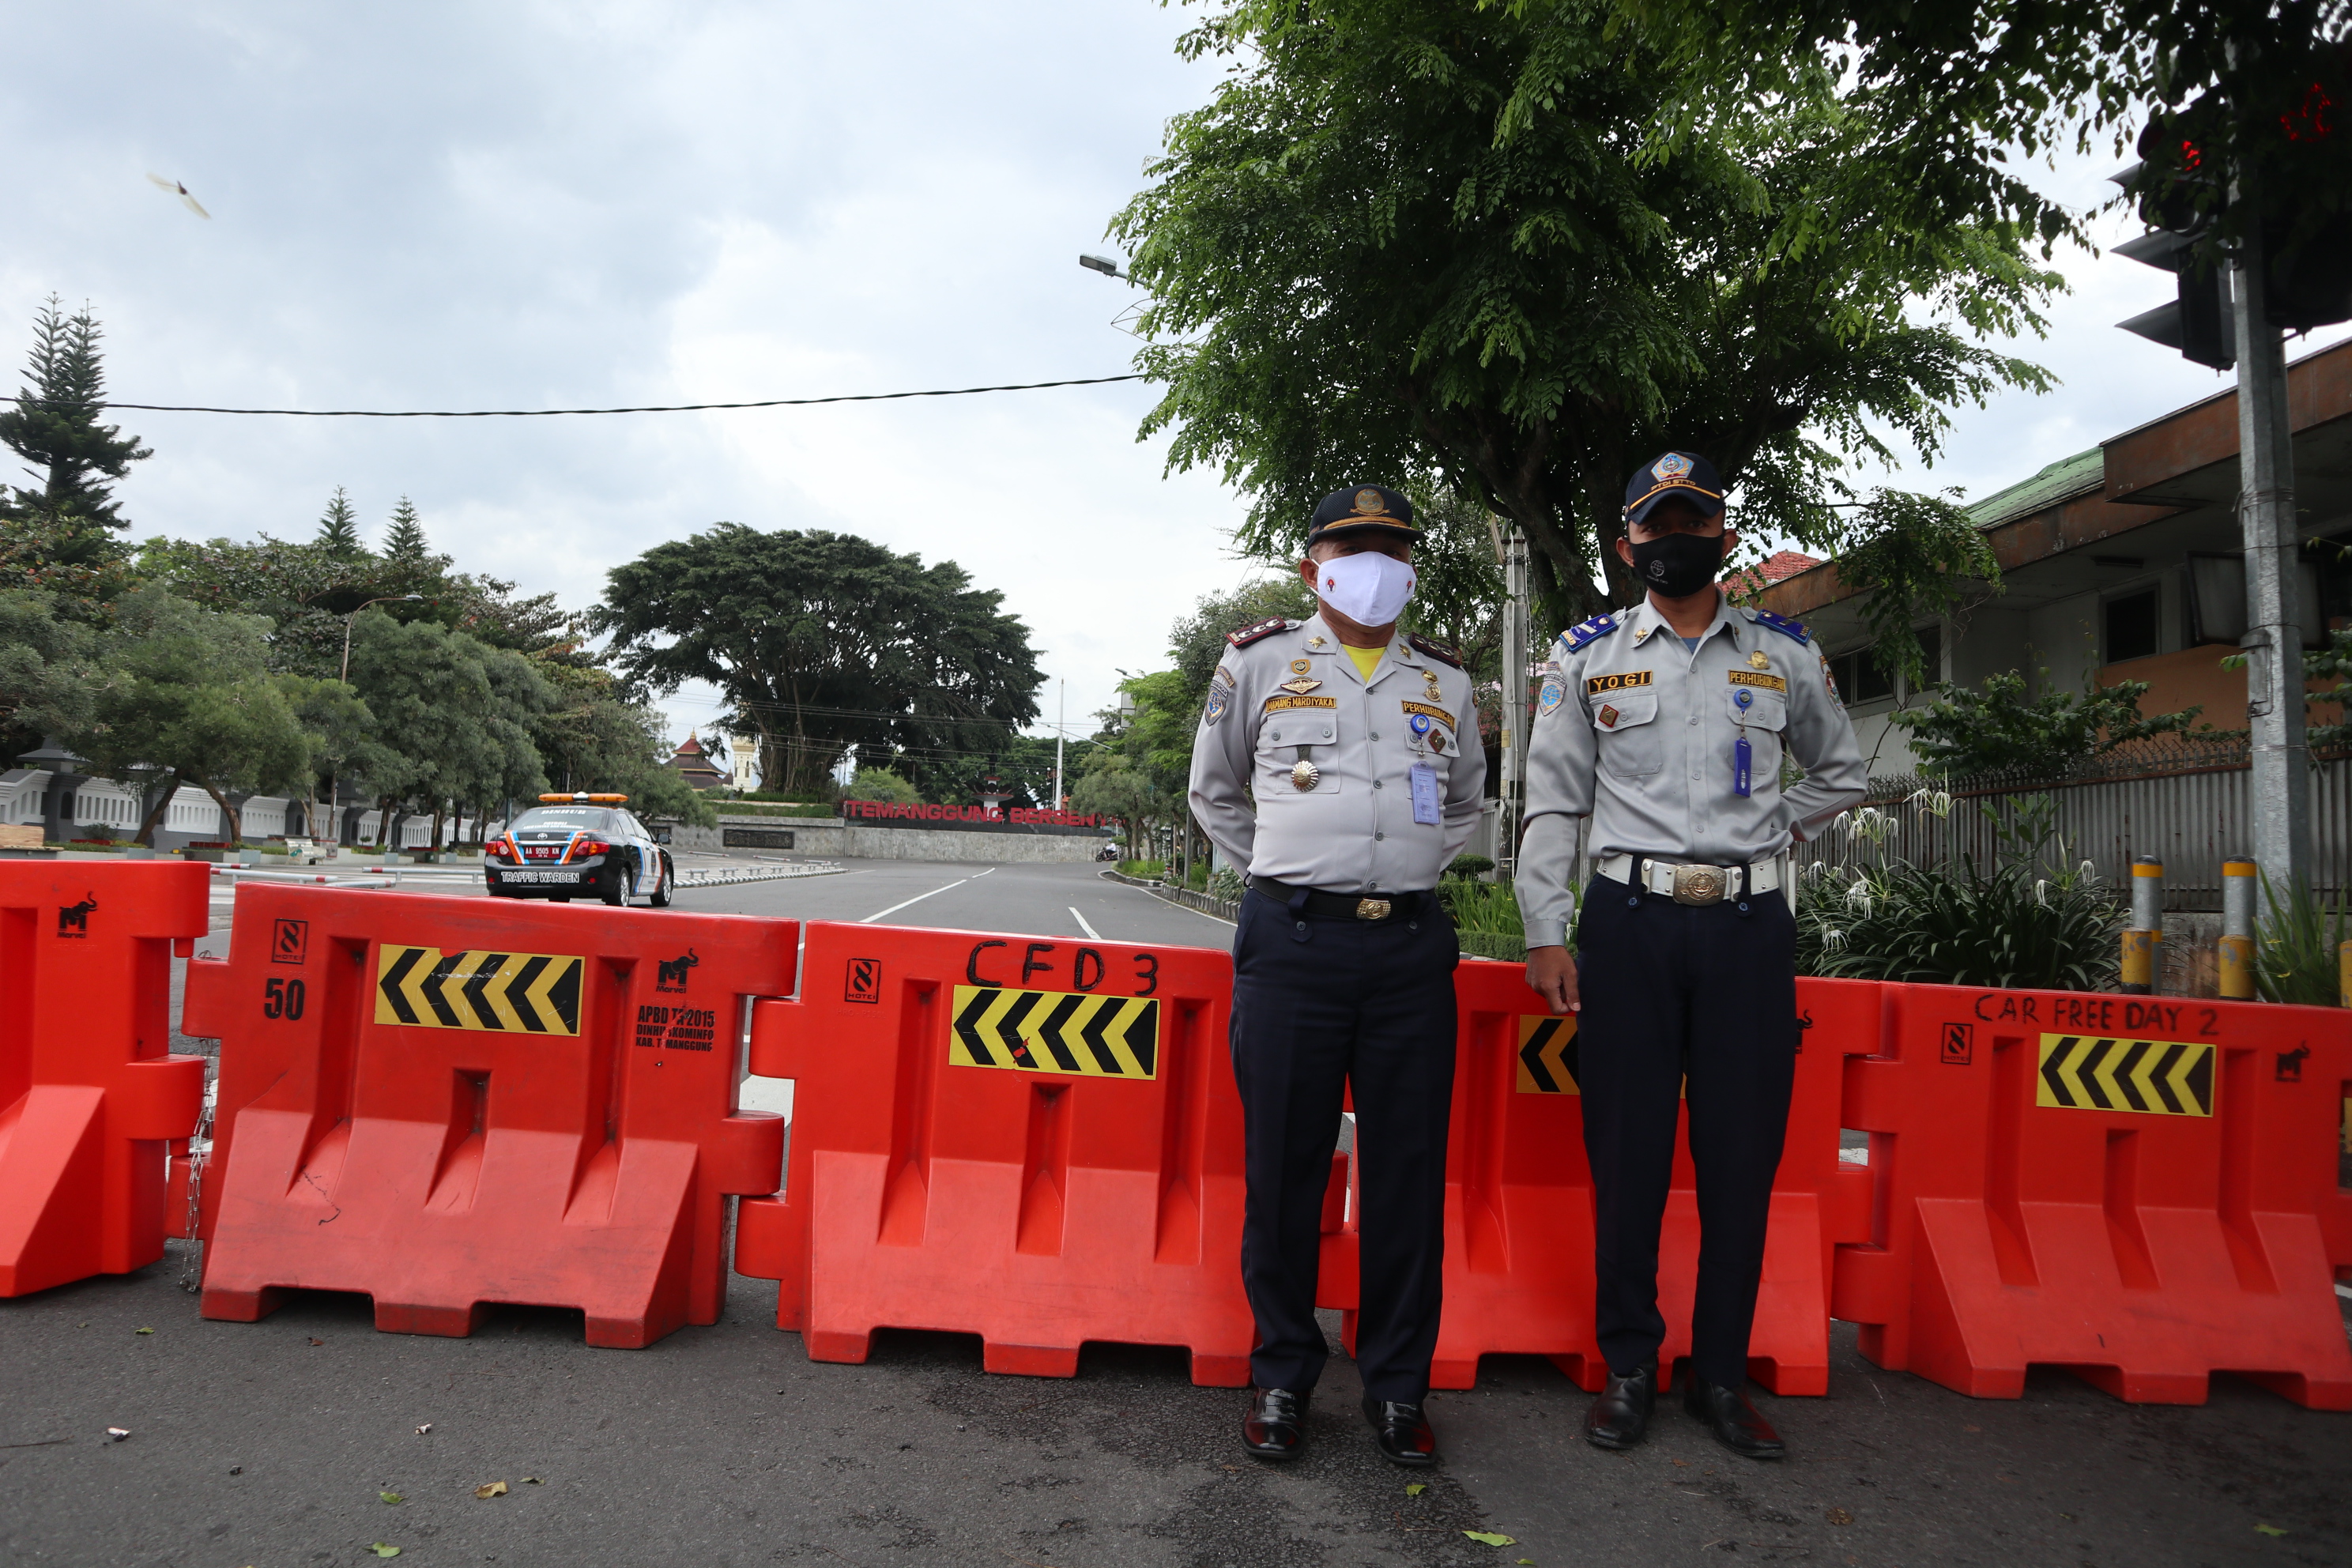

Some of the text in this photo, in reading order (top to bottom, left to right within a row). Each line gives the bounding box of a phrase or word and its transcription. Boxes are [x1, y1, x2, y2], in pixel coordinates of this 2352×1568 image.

[1651, 481, 1671, 491] PTDI
[1593, 673, 1646, 691] YOGI
[1731, 672, 1785, 690] PERHUBUNGAN
[1293, 697, 1333, 707] MARDIYAKA
[1404, 702, 1455, 729] PERHUBUNGAN
[846, 801, 1004, 823] TEMANGGUNG
[501, 872, 580, 884] TRAFFIC WARDEN
[1133, 954, 1159, 996] 3
[656, 986, 687, 994] Marvel
[264, 978, 306, 1021] 50
[637, 1005, 669, 1024] APBD
[686, 1009, 715, 1028] 2015
[1975, 993, 2220, 1036] CAR FREE DAY 2
[636, 1023, 714, 1041] DINHUKOMINFO
[635, 1037, 713, 1052] KAB. TMANGGUNG
